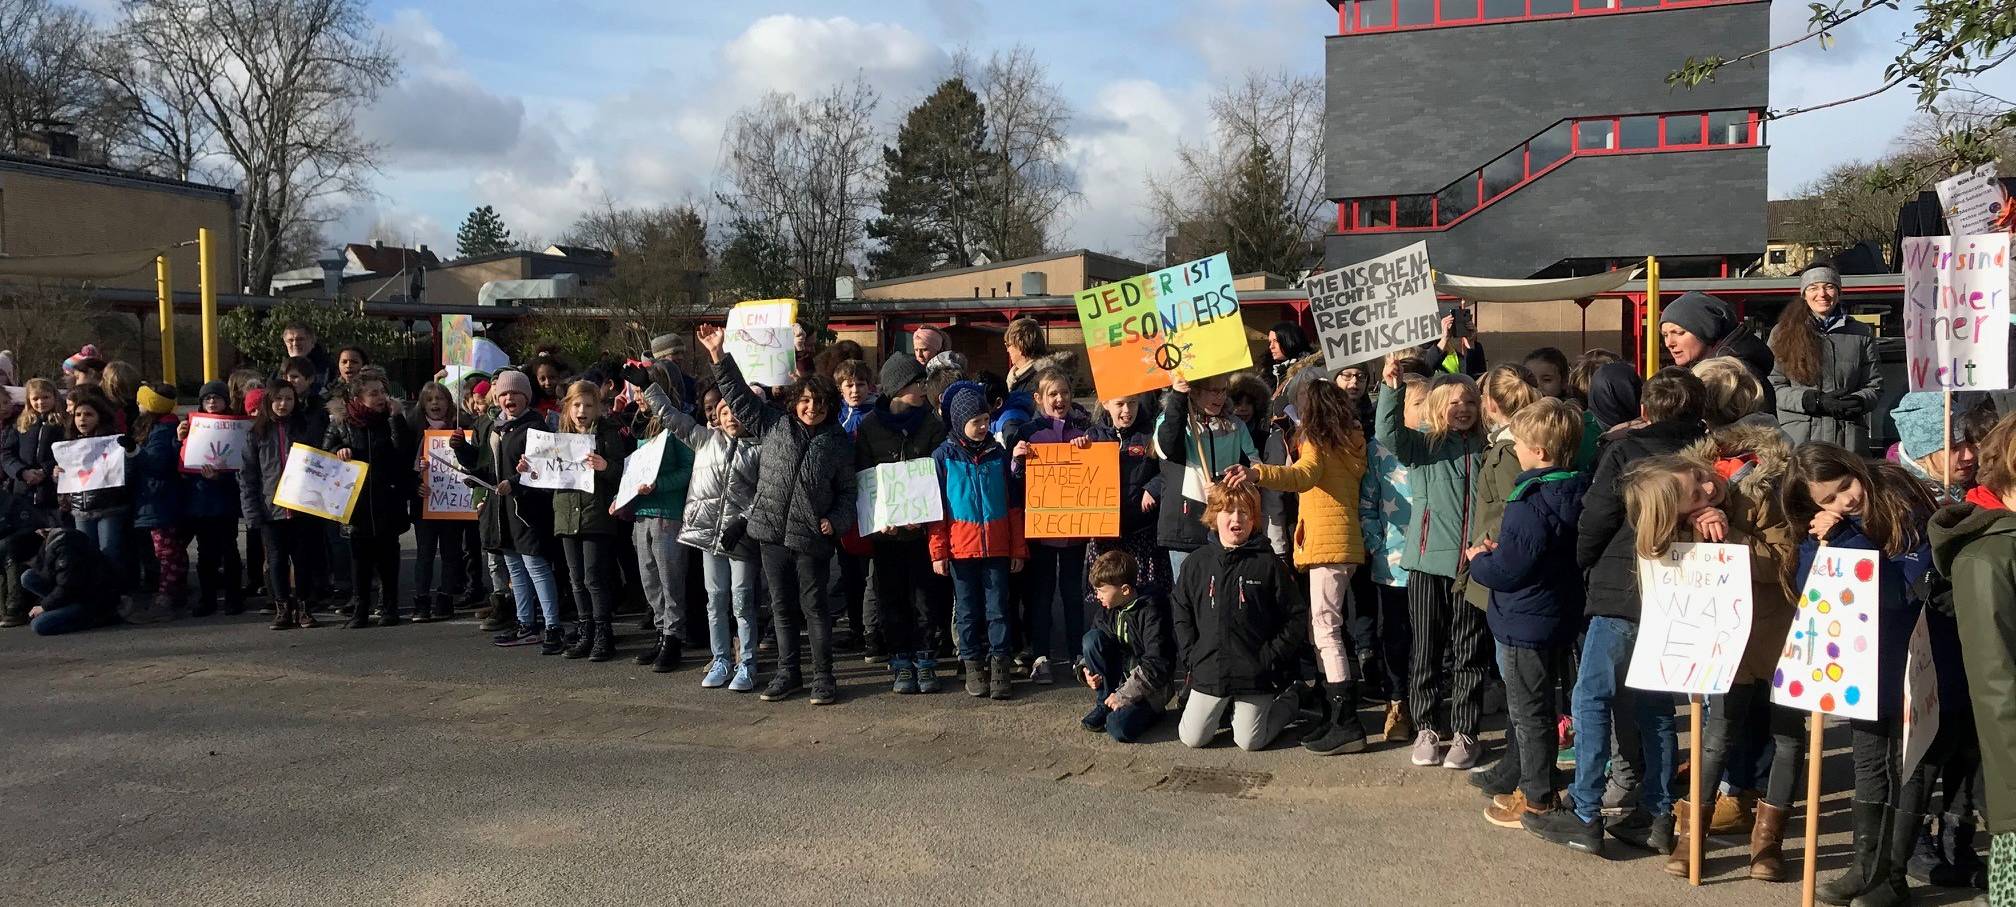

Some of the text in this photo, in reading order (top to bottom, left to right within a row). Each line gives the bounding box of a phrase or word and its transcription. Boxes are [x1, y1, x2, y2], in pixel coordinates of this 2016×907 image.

[1904, 242, 2006, 271] Wir sind
[1082, 258, 1213, 320] JEDER IST
[1306, 250, 1428, 298] MENSCHEN-
[1311, 271, 1428, 312] RECHTE STATT
[1092, 283, 1239, 347] BESONDERS
[1316, 299, 1398, 332] RECHTE
[1906, 313, 1990, 344] einer
[1325, 311, 1442, 360] MENSCHEN
[1911, 357, 1977, 391] Welt
[432, 439, 446, 449] DIE
[1029, 445, 1081, 466] ALLE
[1030, 465, 1100, 485] HABEN
[1027, 485, 1117, 508] GLEICHE
[1033, 512, 1117, 535] RECHTE
[1656, 591, 1743, 630] WAS
[1662, 619, 1731, 659] ER
